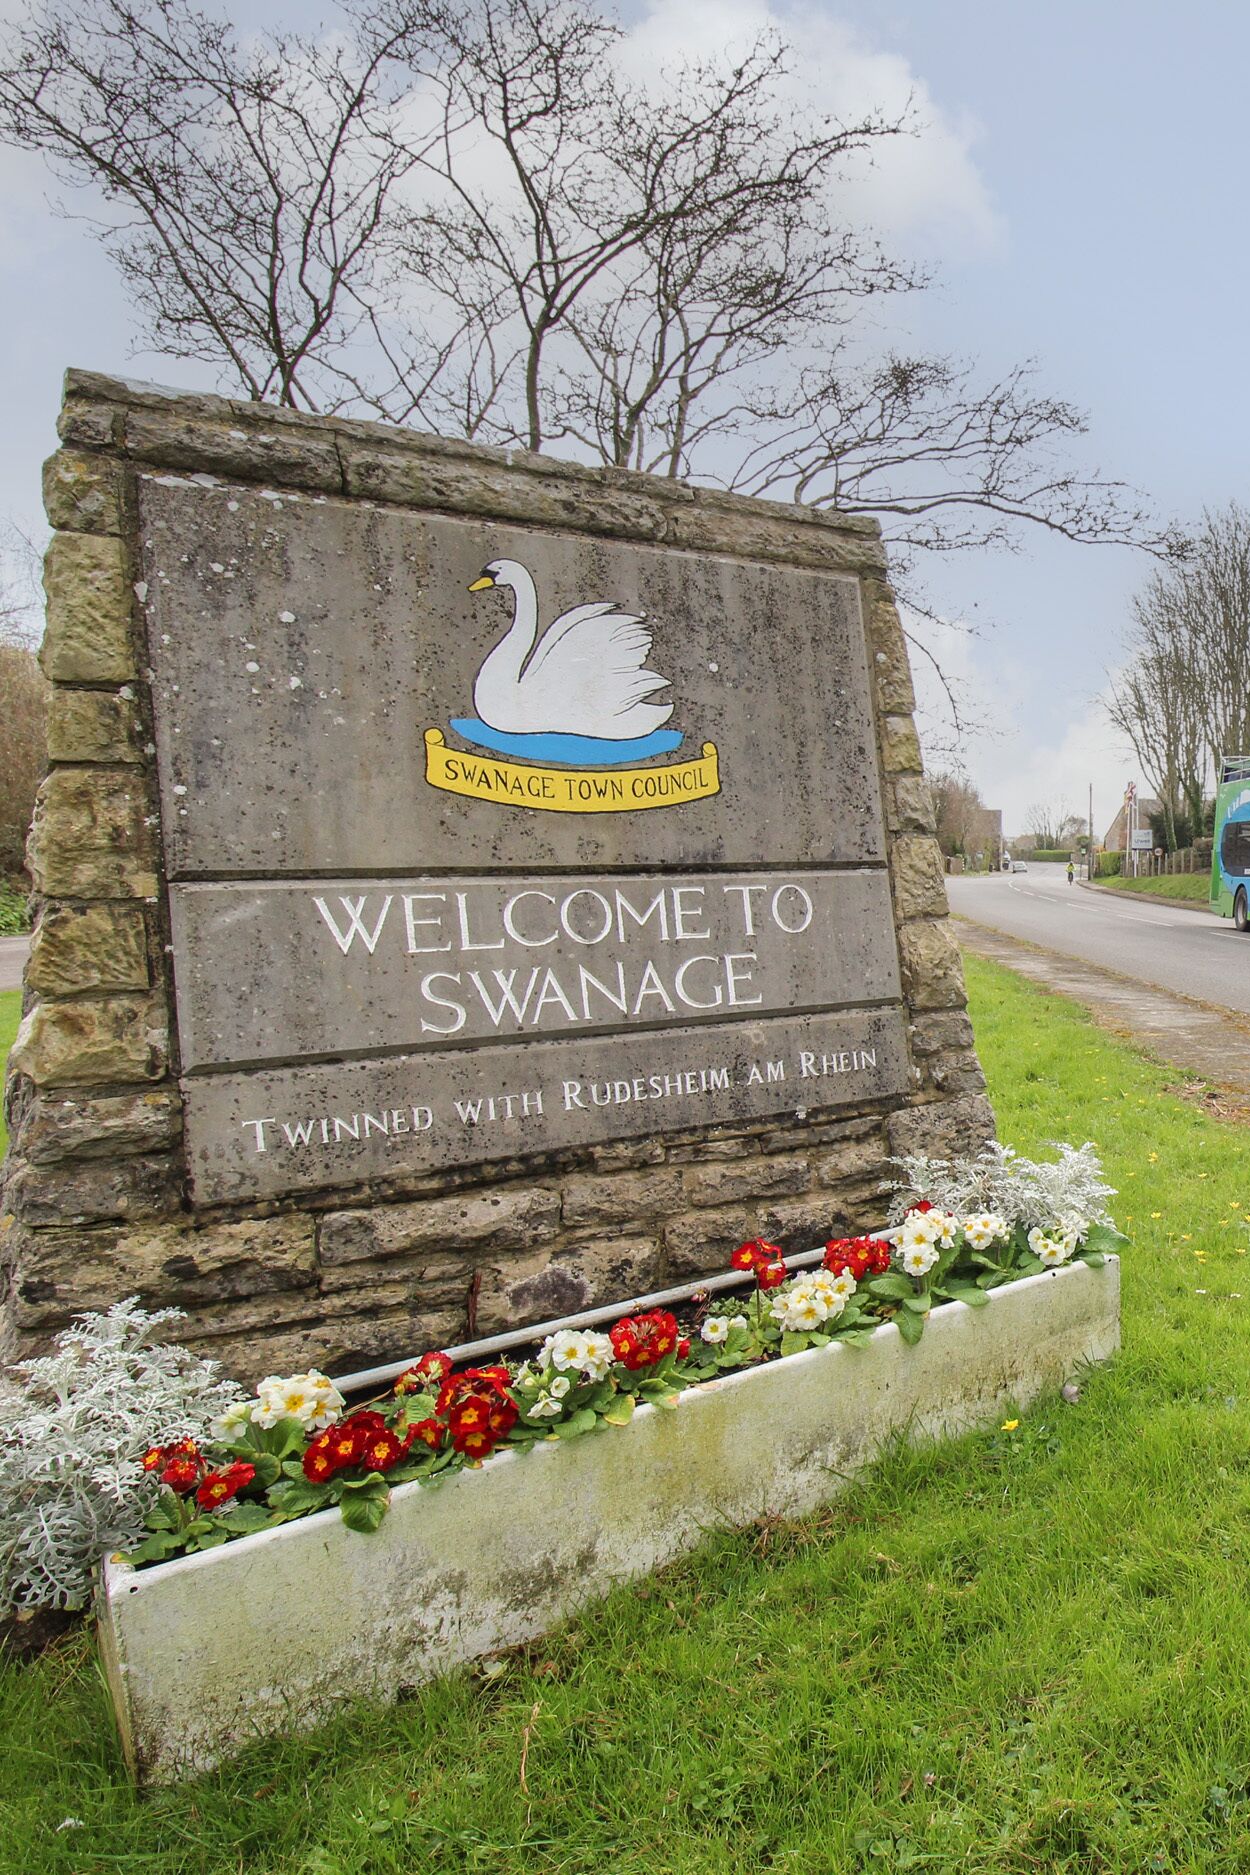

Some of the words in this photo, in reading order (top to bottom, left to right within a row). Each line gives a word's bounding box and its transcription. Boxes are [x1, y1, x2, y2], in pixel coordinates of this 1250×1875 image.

[444, 759, 555, 799] SWANAGE
[564, 779, 624, 801] TOWN
[631, 767, 709, 798] COUNCIL
[312, 885, 711, 955] WELCOME
[723, 884, 813, 934] TO
[420, 953, 763, 1034] SWANAGE
[453, 1091, 543, 1126] WITH
[746, 1060, 786, 1086] AM
